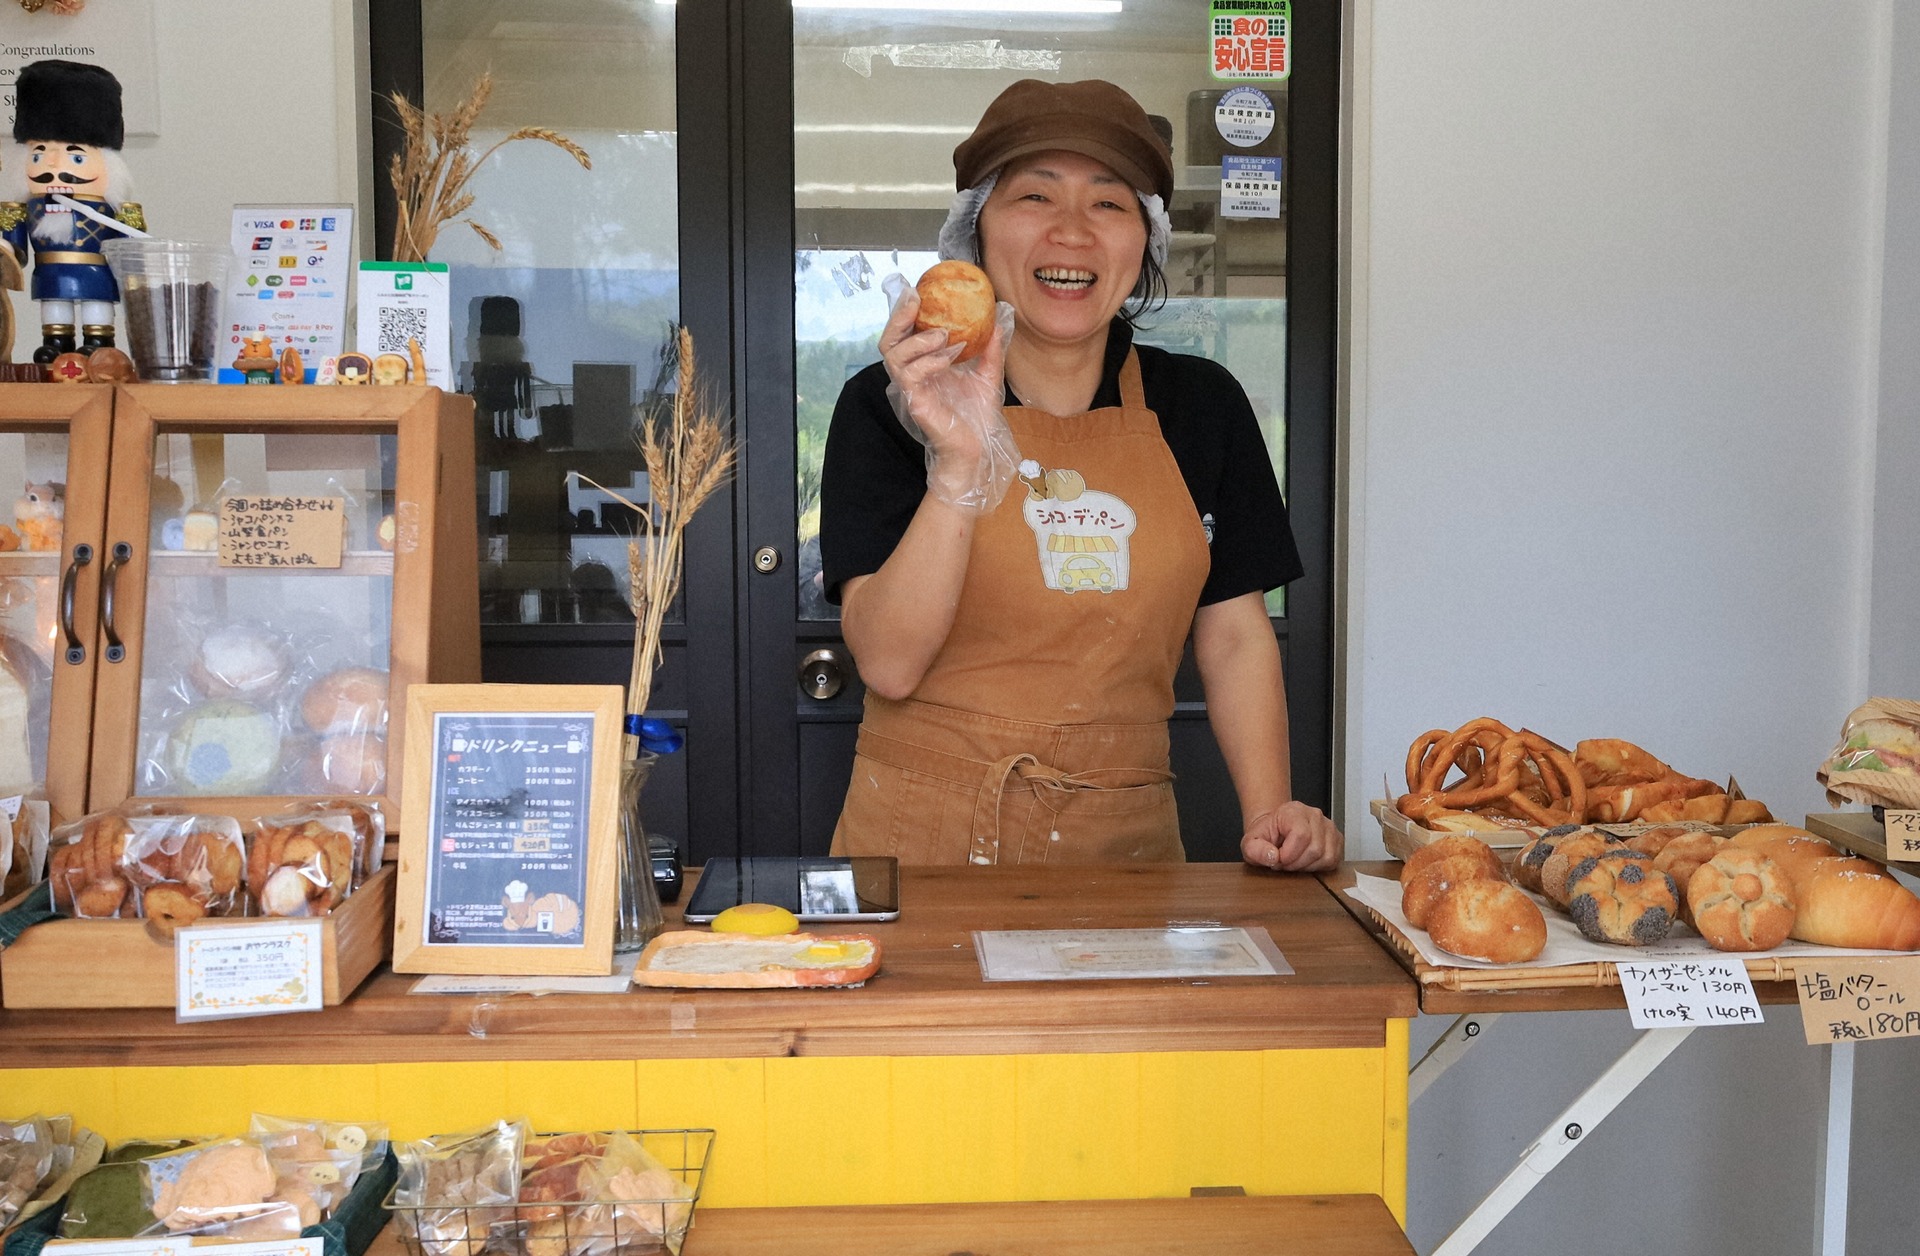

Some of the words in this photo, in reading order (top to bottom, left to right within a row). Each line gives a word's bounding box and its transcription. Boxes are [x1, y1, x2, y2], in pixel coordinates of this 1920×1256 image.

[1233, 17, 1268, 36] 食の
[1215, 37, 1286, 72] 安心宣言
[254, 221, 274, 229] VISA
[245, 940, 291, 950] おやつラスク
[256, 953, 284, 962] 350円
[1641, 983, 1689, 996] ノーマル
[1702, 981, 1747, 994] 130円
[1800, 972, 1887, 1001] 塩バター
[1857, 992, 1906, 1011] ロール
[1643, 1003, 1694, 1021] けしの実
[1706, 1005, 1757, 1021] 140円
